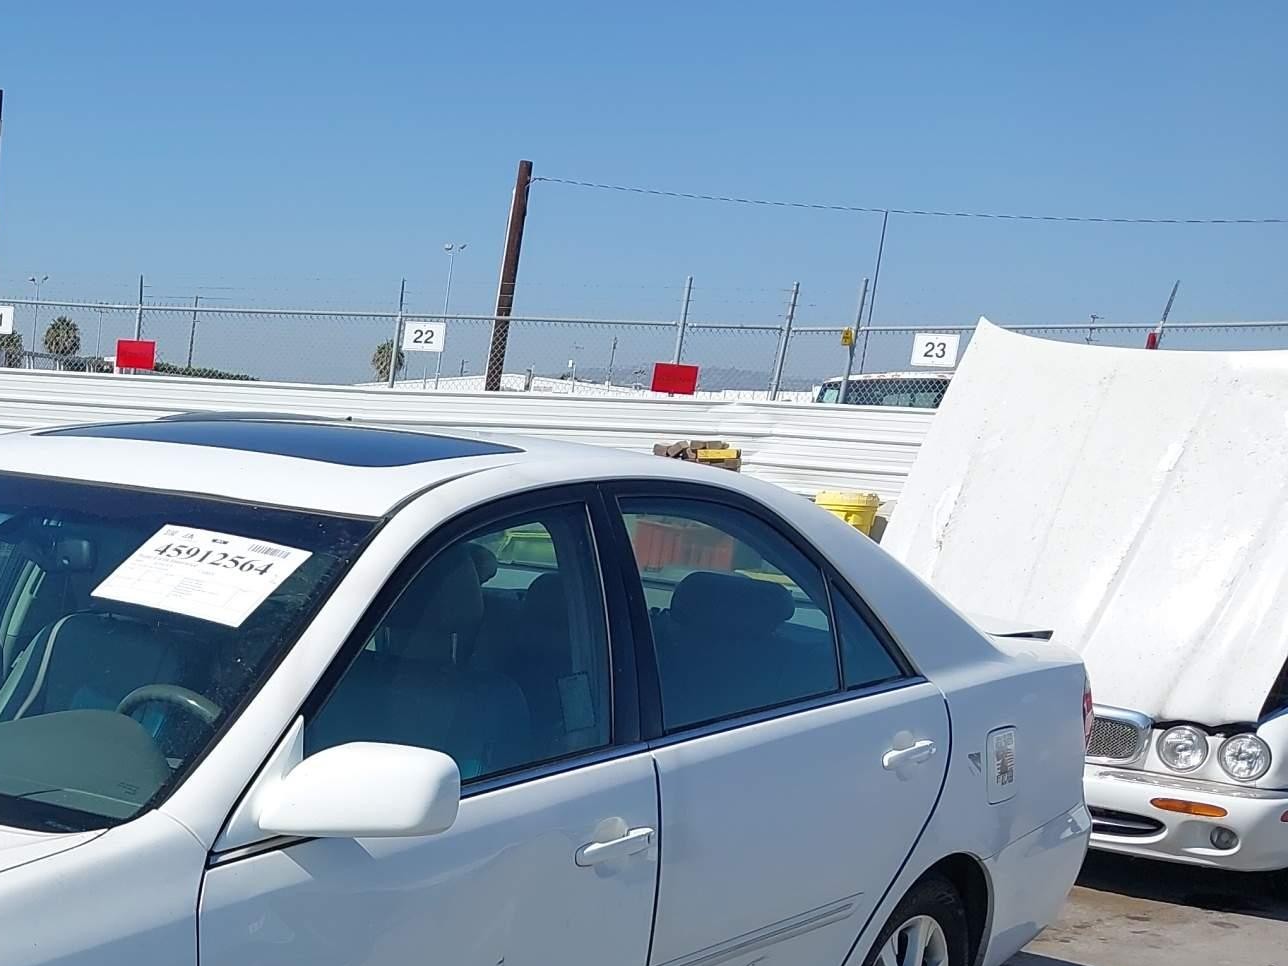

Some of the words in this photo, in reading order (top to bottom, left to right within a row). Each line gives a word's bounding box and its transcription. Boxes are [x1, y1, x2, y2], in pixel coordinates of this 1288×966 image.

[413, 329, 435, 344] 22
[923, 342, 947, 359] 23
[154, 543, 274, 576] 45912564
